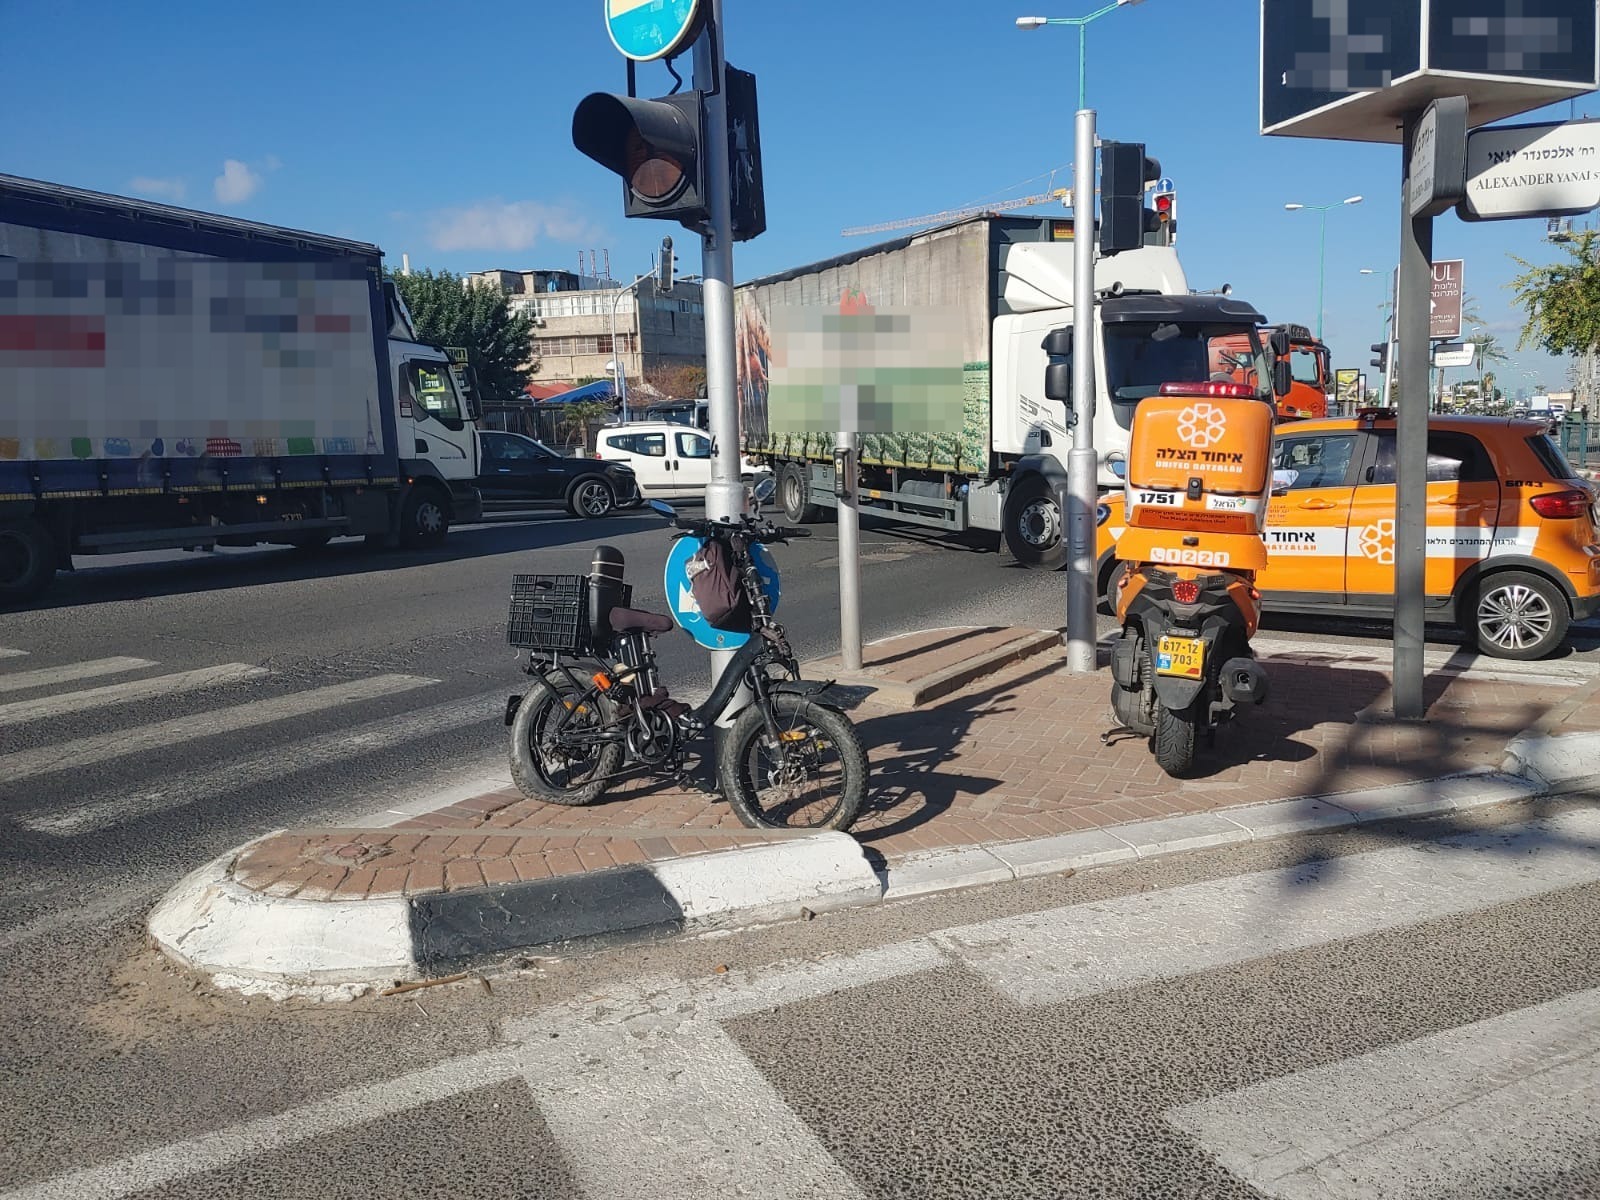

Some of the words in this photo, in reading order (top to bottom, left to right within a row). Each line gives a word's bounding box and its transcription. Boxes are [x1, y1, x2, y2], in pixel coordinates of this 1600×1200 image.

[1487, 149, 1518, 165] ינאי
[1522, 146, 1575, 161] אלכסנדר
[1476, 172, 1554, 190] ALEXANDER
[1556, 170, 1591, 183] YANAI
[1430, 264, 1456, 282] UL
[1156, 448, 1197, 460] הצלה
[1201, 451, 1243, 463] איחוד
[1155, 460, 1190, 470] UNITED
[1140, 493, 1175, 505] 1751
[1213, 498, 1236, 508] הראל
[1270, 531, 1316, 543] איחוד
[1427, 536, 1447, 545] הלאו
[1449, 538, 1491, 546] המתנדבים
[1494, 538, 1517, 548] ארגון
[1166, 549, 1229, 567] 1221
[1163, 641, 1199, 654] 617-12
[1173, 654, 1192, 666] 703
